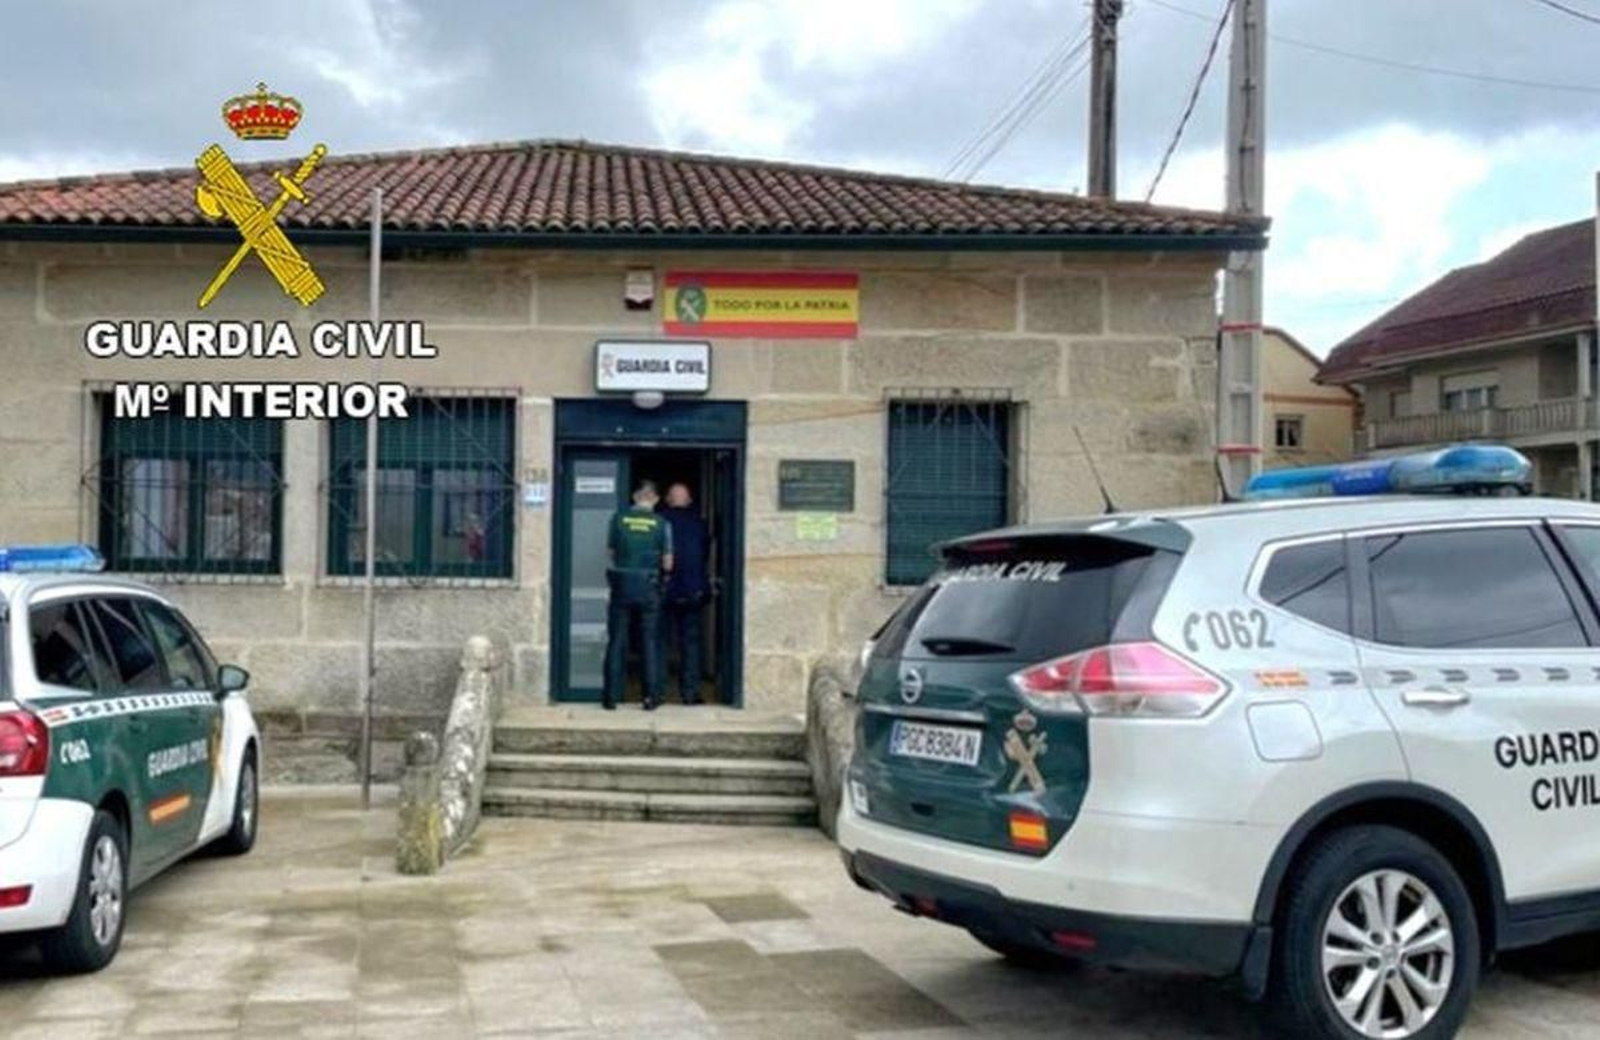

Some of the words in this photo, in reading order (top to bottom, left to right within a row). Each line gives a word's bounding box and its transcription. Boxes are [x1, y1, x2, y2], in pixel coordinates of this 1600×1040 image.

[713, 300, 752, 310] TODO
[755, 300, 782, 310] POR
[784, 300, 801, 310] LA
[804, 300, 851, 310] PATRIA
[616, 359, 671, 375] GUARDIA
[675, 359, 706, 375] CIVIL
[1008, 560, 1067, 581] CIVIL
[1205, 608, 1276, 650] 062
[1494, 730, 1600, 769] GUARD
[1531, 774, 1600, 811] CIVIL
